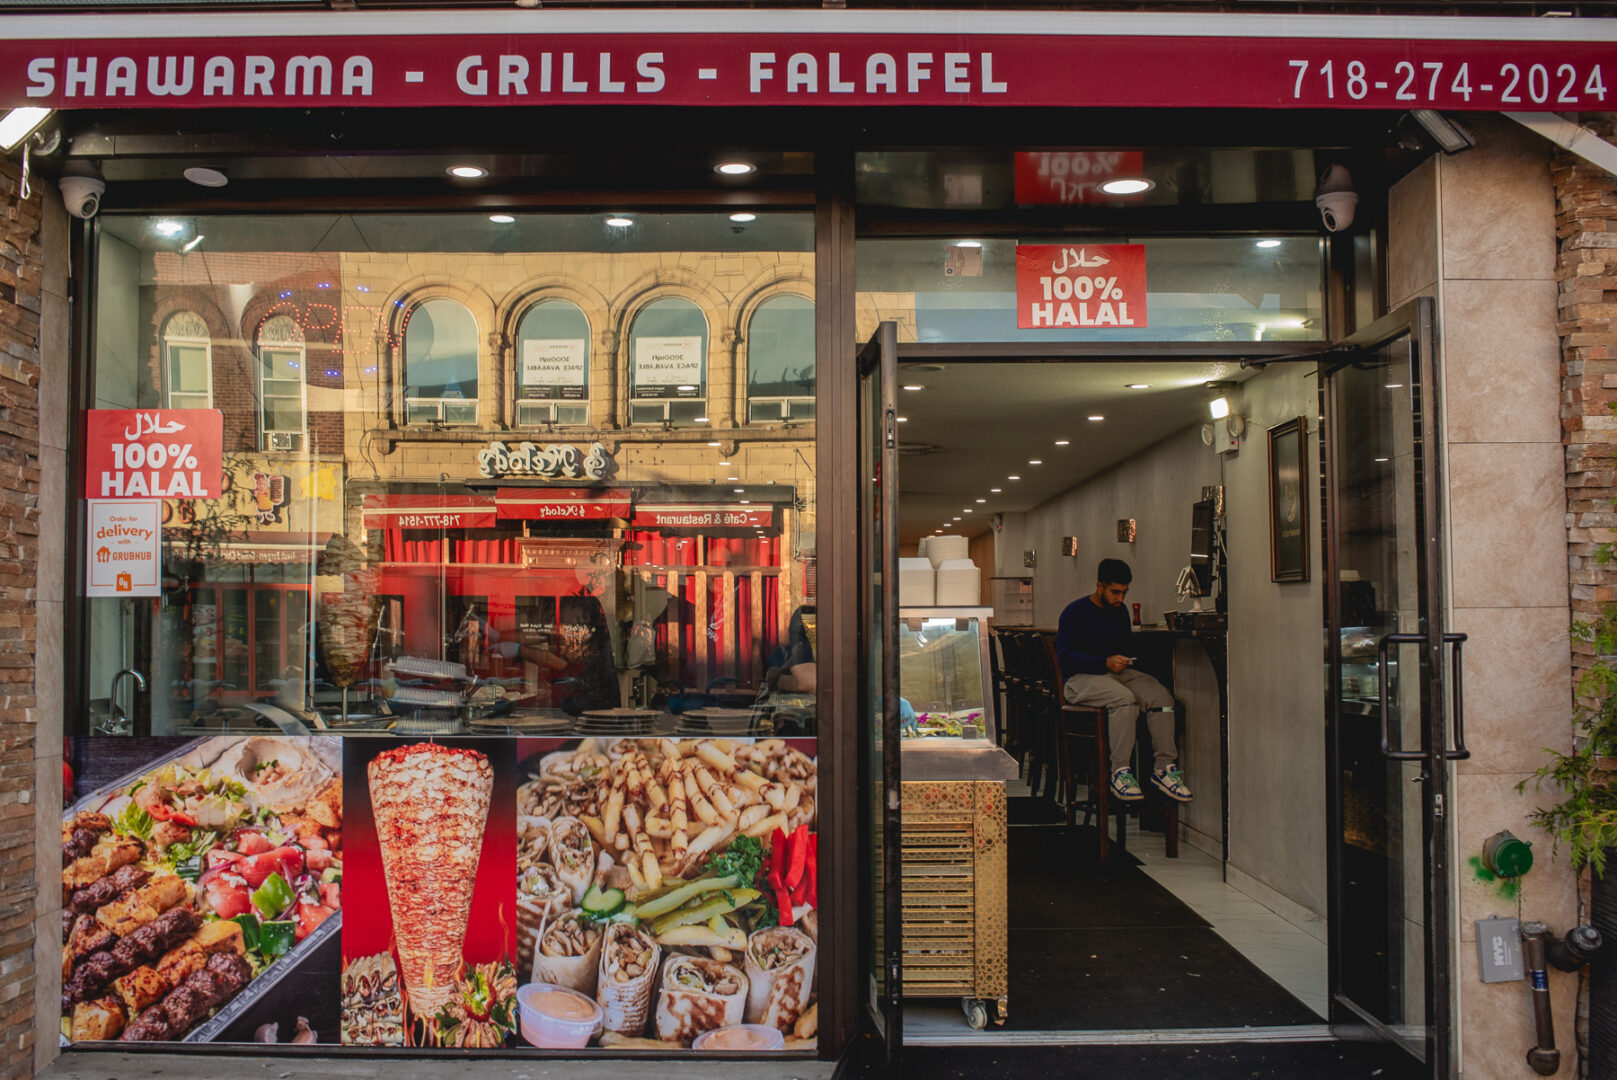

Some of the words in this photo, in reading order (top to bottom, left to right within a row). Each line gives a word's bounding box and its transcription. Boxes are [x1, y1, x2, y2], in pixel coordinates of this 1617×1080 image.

[26, 54, 374, 98] SHAWARMA
[456, 52, 667, 96] GRILLS
[750, 52, 1008, 94] FALAFEL
[1289, 59, 1608, 103] 718-274-2024
[1052, 248, 1111, 274] حلال
[1040, 276, 1124, 300] 100%
[1032, 302, 1134, 326] HALAL
[125, 412, 187, 441] حلال
[112, 443, 198, 469] 100%
[101, 471, 208, 497] HALAL
[96, 524, 153, 540] delivery
[112, 551, 152, 561] GRUBHUB
